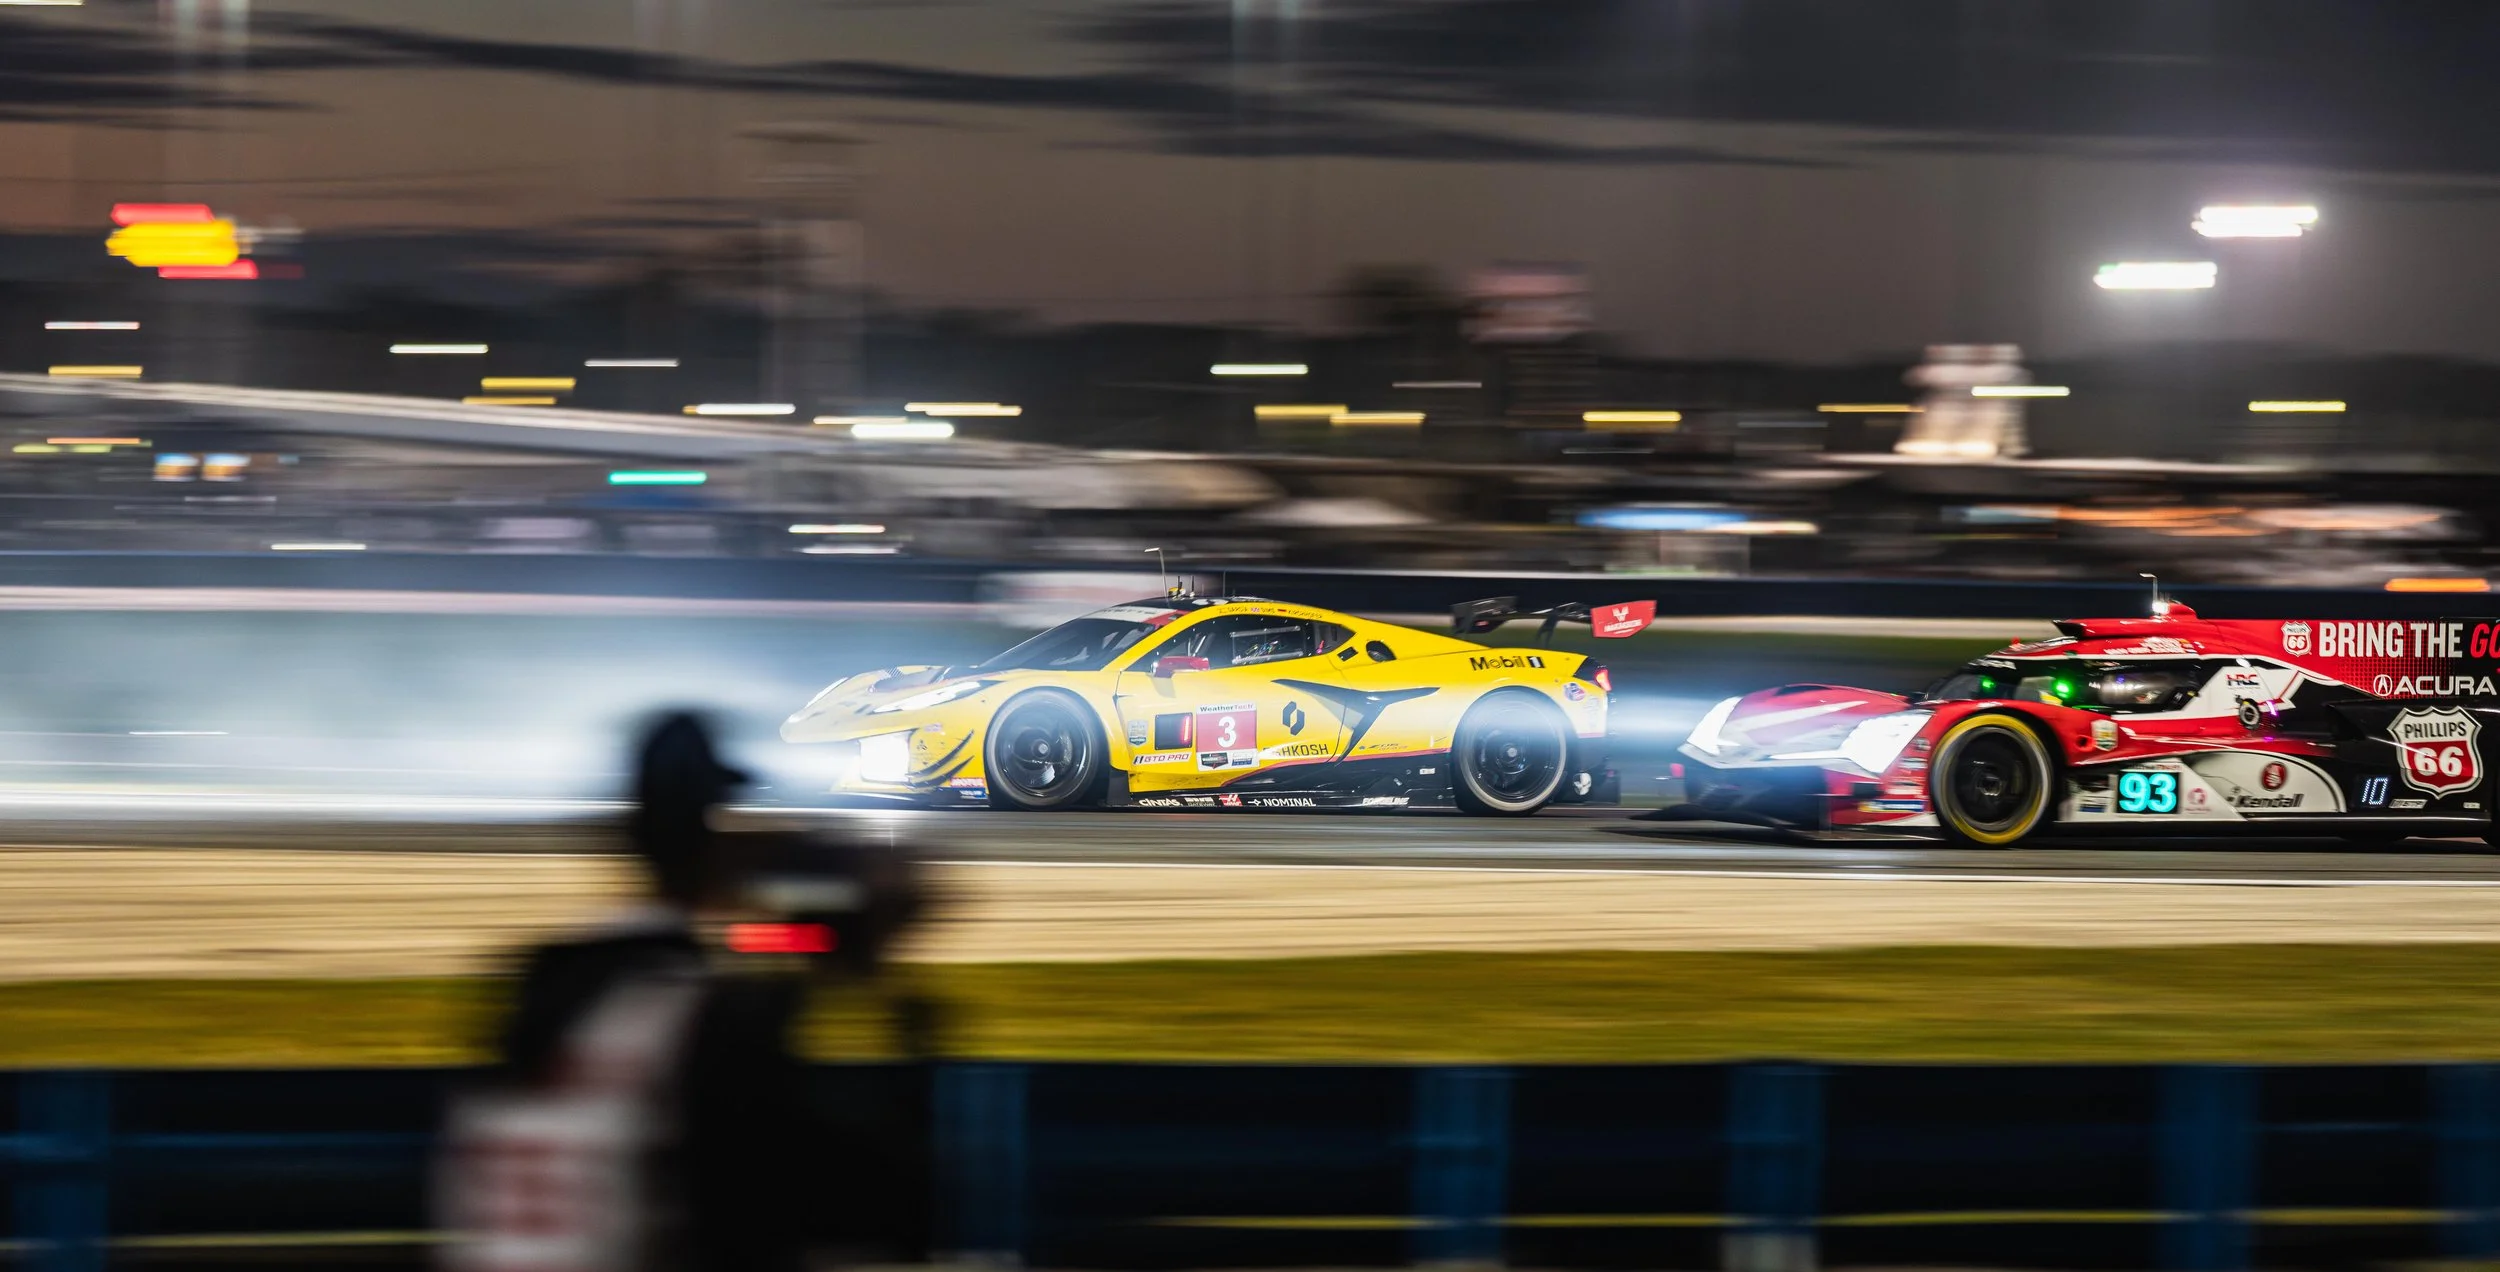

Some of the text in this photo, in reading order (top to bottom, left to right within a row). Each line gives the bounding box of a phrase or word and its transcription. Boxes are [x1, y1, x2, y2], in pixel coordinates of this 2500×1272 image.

[2288, 635, 2306, 649] 66
[2319, 622, 2404, 658] BRING
[2410, 623, 2463, 658] THE
[1469, 656, 1544, 671] Mobil 1
[2393, 675, 2497, 695] ACURA
[1200, 703, 1254, 712] WeatherTech
[1218, 716, 1237, 748] 3
[2404, 721, 2467, 738] PHILLIPS
[1263, 744, 1329, 757] HKOSH
[2413, 745, 2465, 777] 66
[2119, 772, 2177, 812] 93
[2361, 778, 2388, 805] 10
[1139, 798, 1181, 807] CINTAS
[1263, 798, 1317, 807] NOMINAL
[2235, 793, 2304, 808] Kendall
